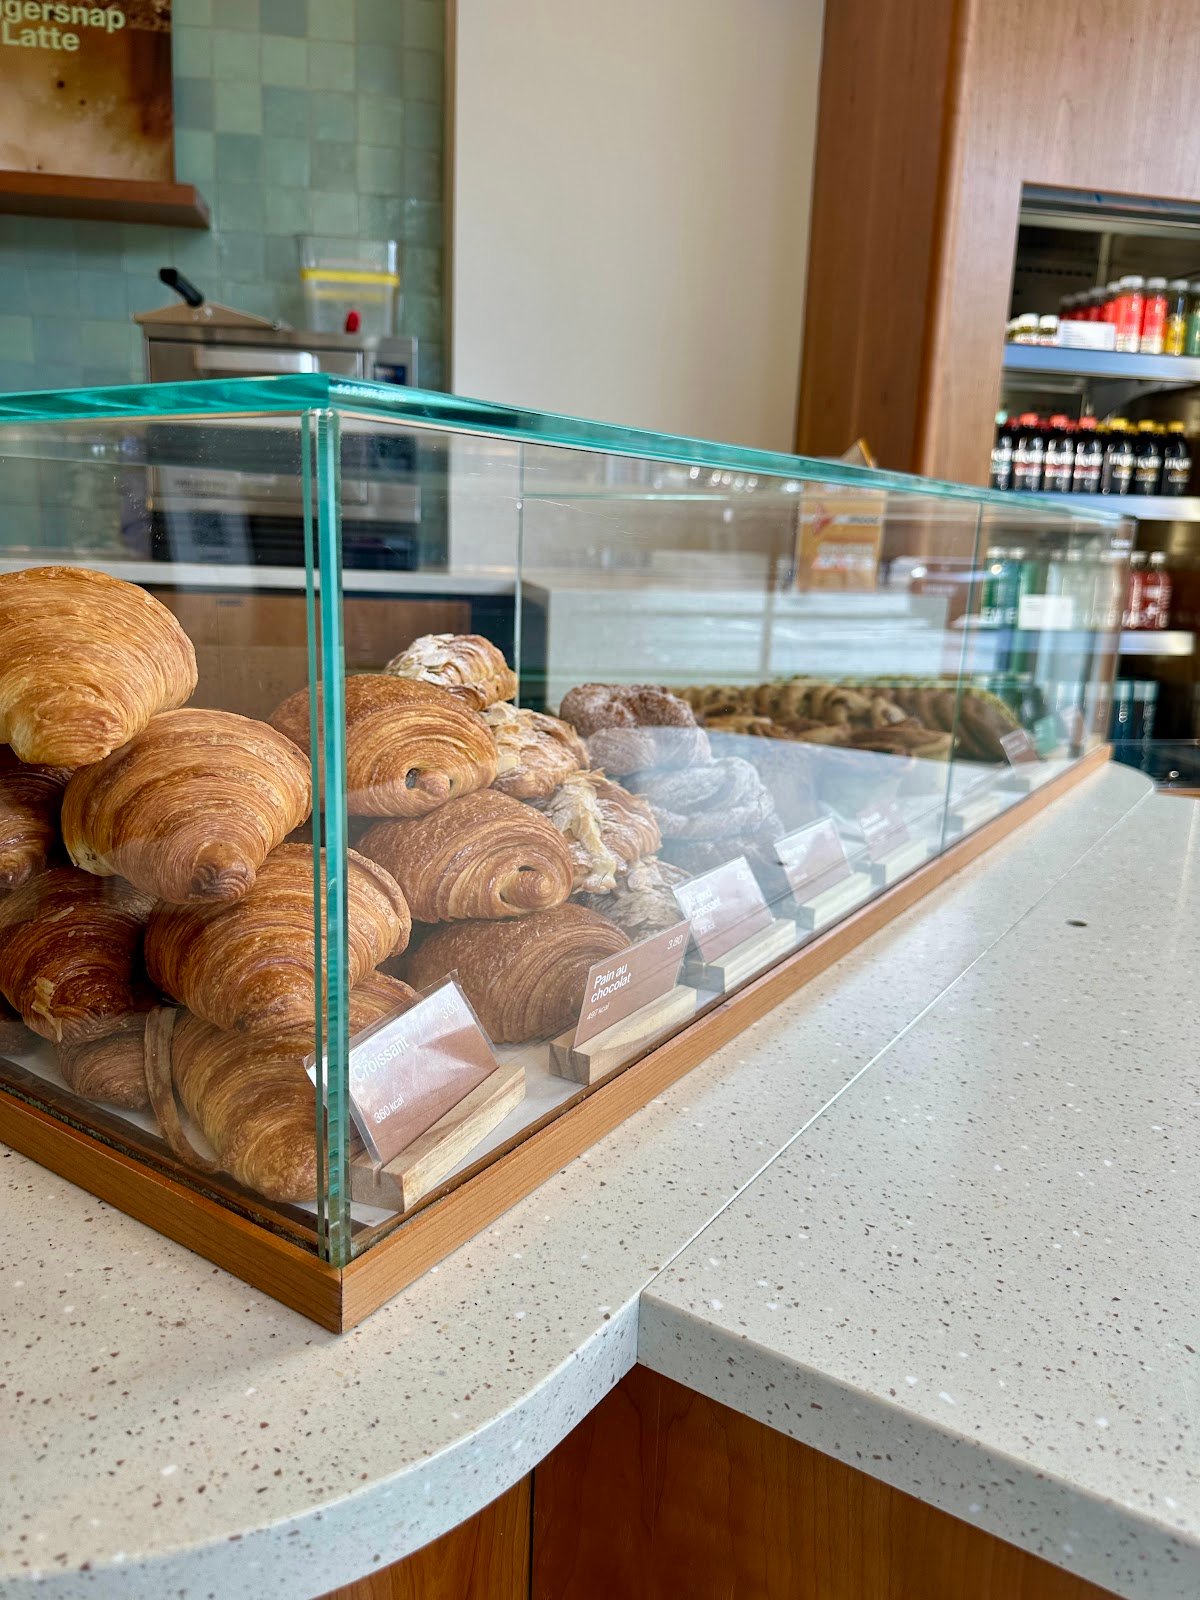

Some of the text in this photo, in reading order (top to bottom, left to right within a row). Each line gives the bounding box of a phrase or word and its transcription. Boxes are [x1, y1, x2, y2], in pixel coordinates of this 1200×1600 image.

[0, 0, 126, 34] gersnap
[2, 21, 80, 51] Latte
[591, 972, 632, 1003] chocolat
[594, 963, 628, 989] Pain au
[352, 1035, 410, 1082] Croissant
[373, 1093, 405, 1124] 360 kcal
